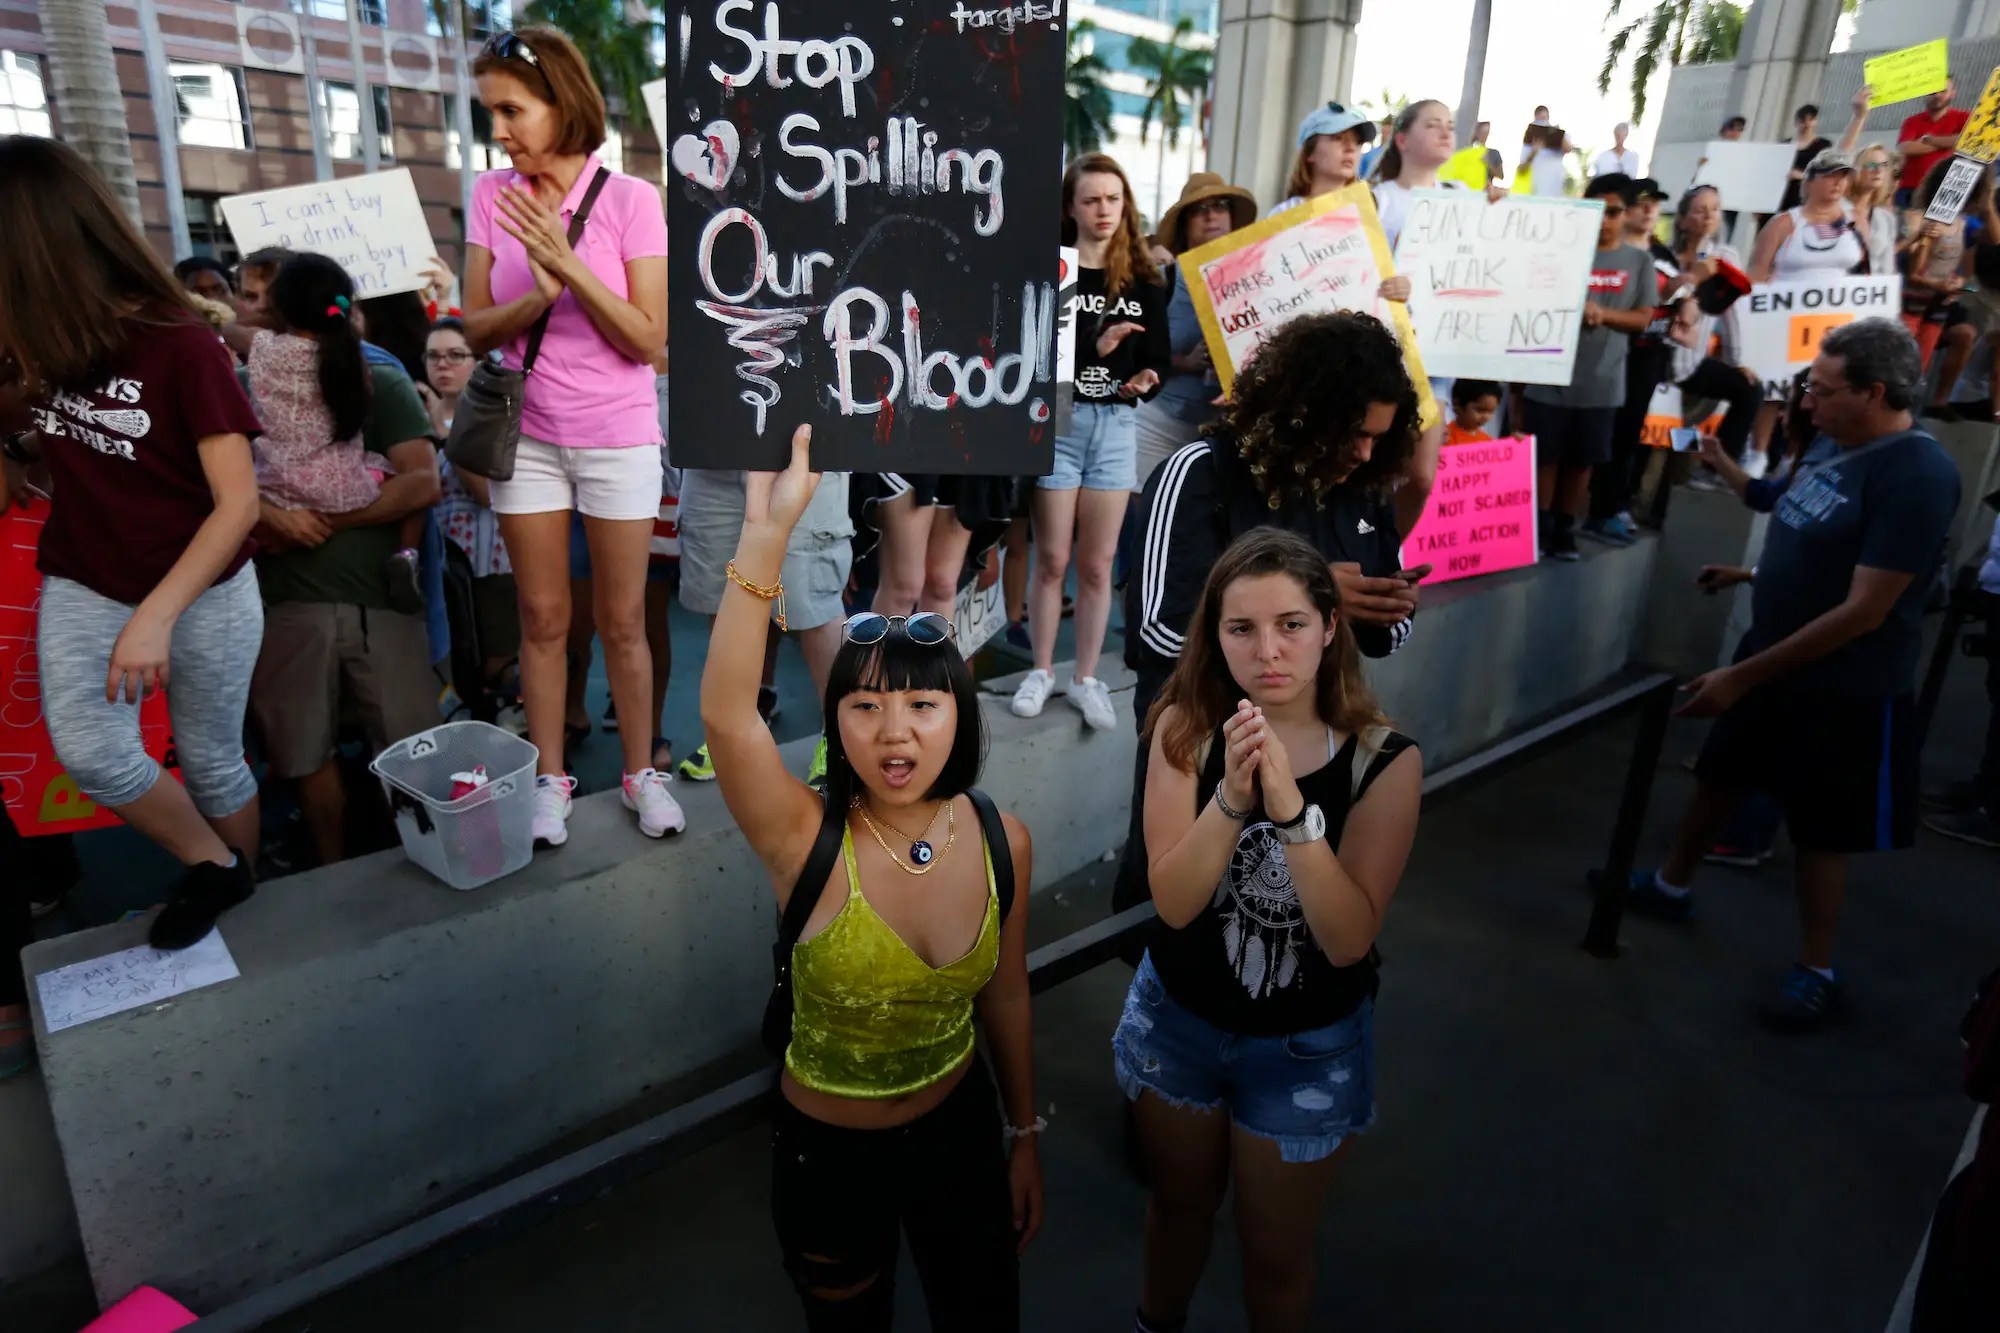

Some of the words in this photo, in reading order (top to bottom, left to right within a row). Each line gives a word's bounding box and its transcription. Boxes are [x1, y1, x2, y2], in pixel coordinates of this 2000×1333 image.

[950, 0, 1061, 35] targets!
[708, 0, 874, 118] Stop
[775, 113, 1004, 236] Spilling
[251, 200, 275, 228] I
[286, 192, 336, 219] can't
[346, 189, 383, 218] buy
[1410, 200, 1463, 244] GUN
[1479, 206, 1580, 247] LAWS
[278, 233, 292, 247] a
[365, 241, 407, 268] buy
[699, 207, 835, 303] Our
[1430, 257, 1506, 290] WEAK
[1751, 286, 1887, 313] ENOUGH
[1434, 311, 1497, 344] ARE
[1508, 309, 1577, 347] NOT
[822, 282, 1057, 423] Blood!
[1456, 447, 1513, 468] SHOULD
[1441, 472, 1490, 494] HAPPY
[1438, 500, 1465, 518] NOT
[1474, 490, 1531, 511] SCARED
[1416, 532, 1457, 551] TAKE
[1469, 523, 1520, 543] ACTION
[1448, 554, 1481, 572] NOW
